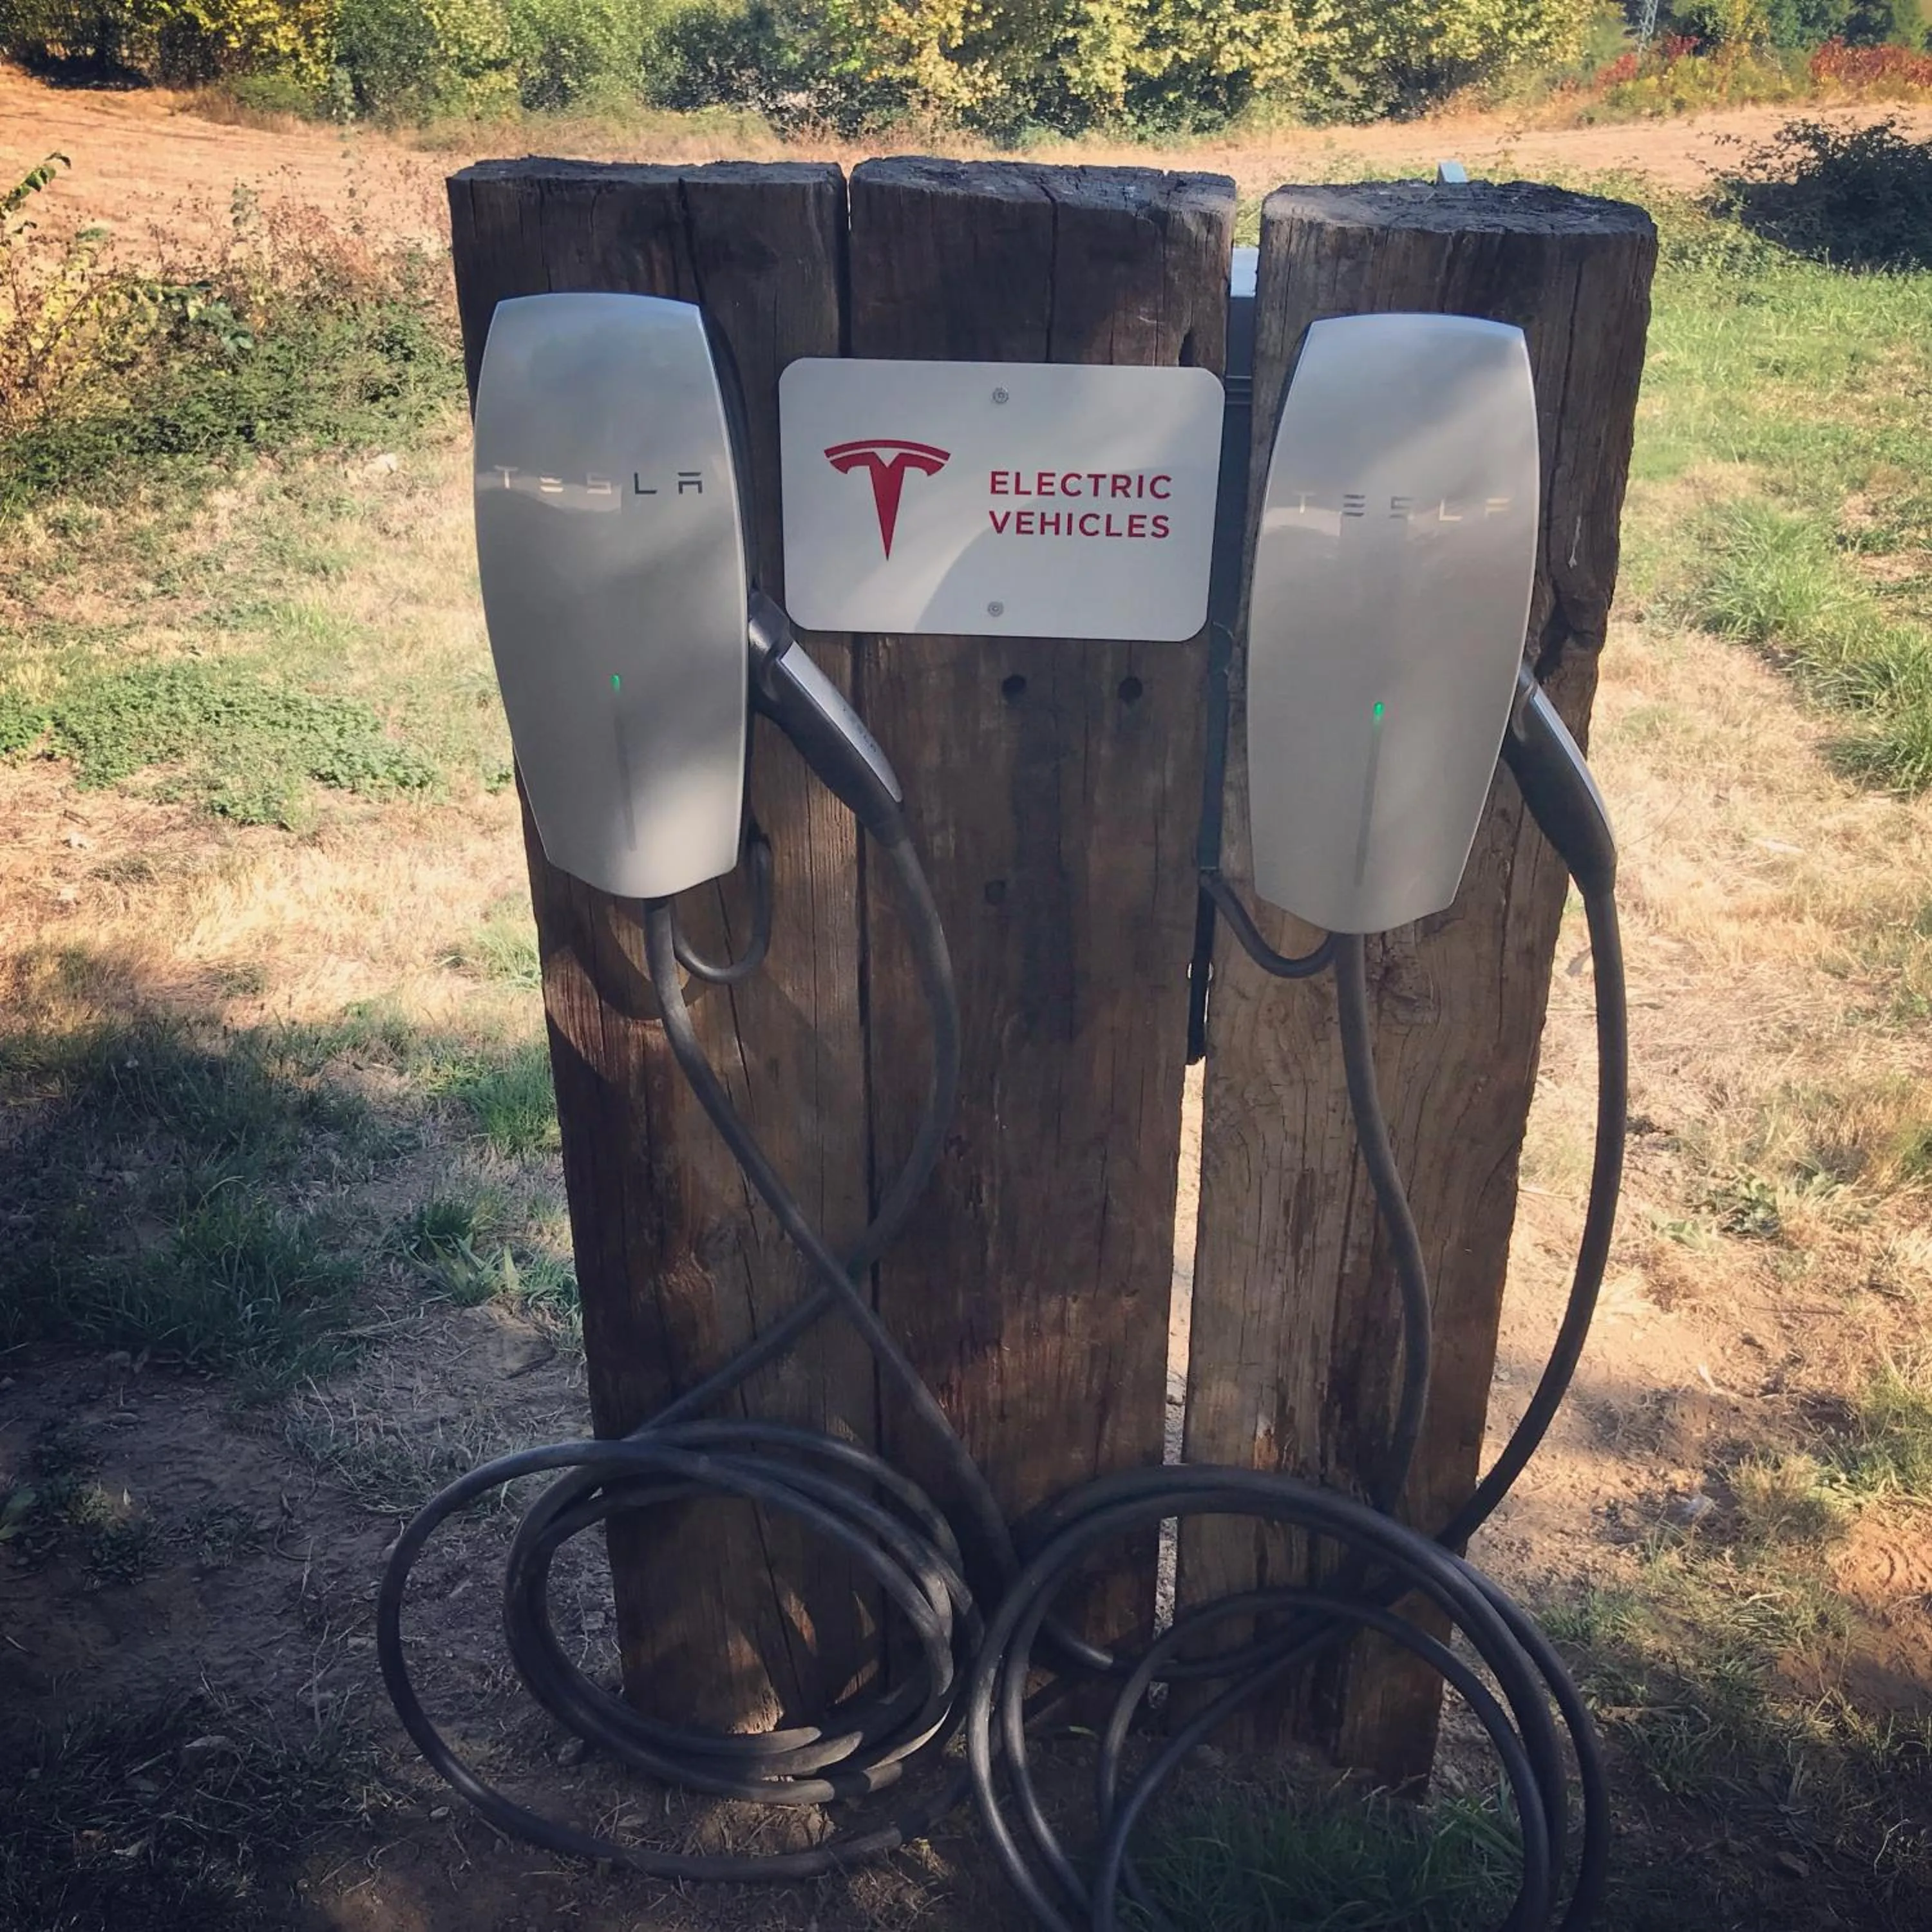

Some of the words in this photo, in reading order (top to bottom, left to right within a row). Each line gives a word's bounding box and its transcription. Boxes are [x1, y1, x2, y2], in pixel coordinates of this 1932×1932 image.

[495, 465, 703, 495] TESLA
[990, 471, 1172, 500] ELECTRIC
[989, 510, 1170, 539] VEHICLES
